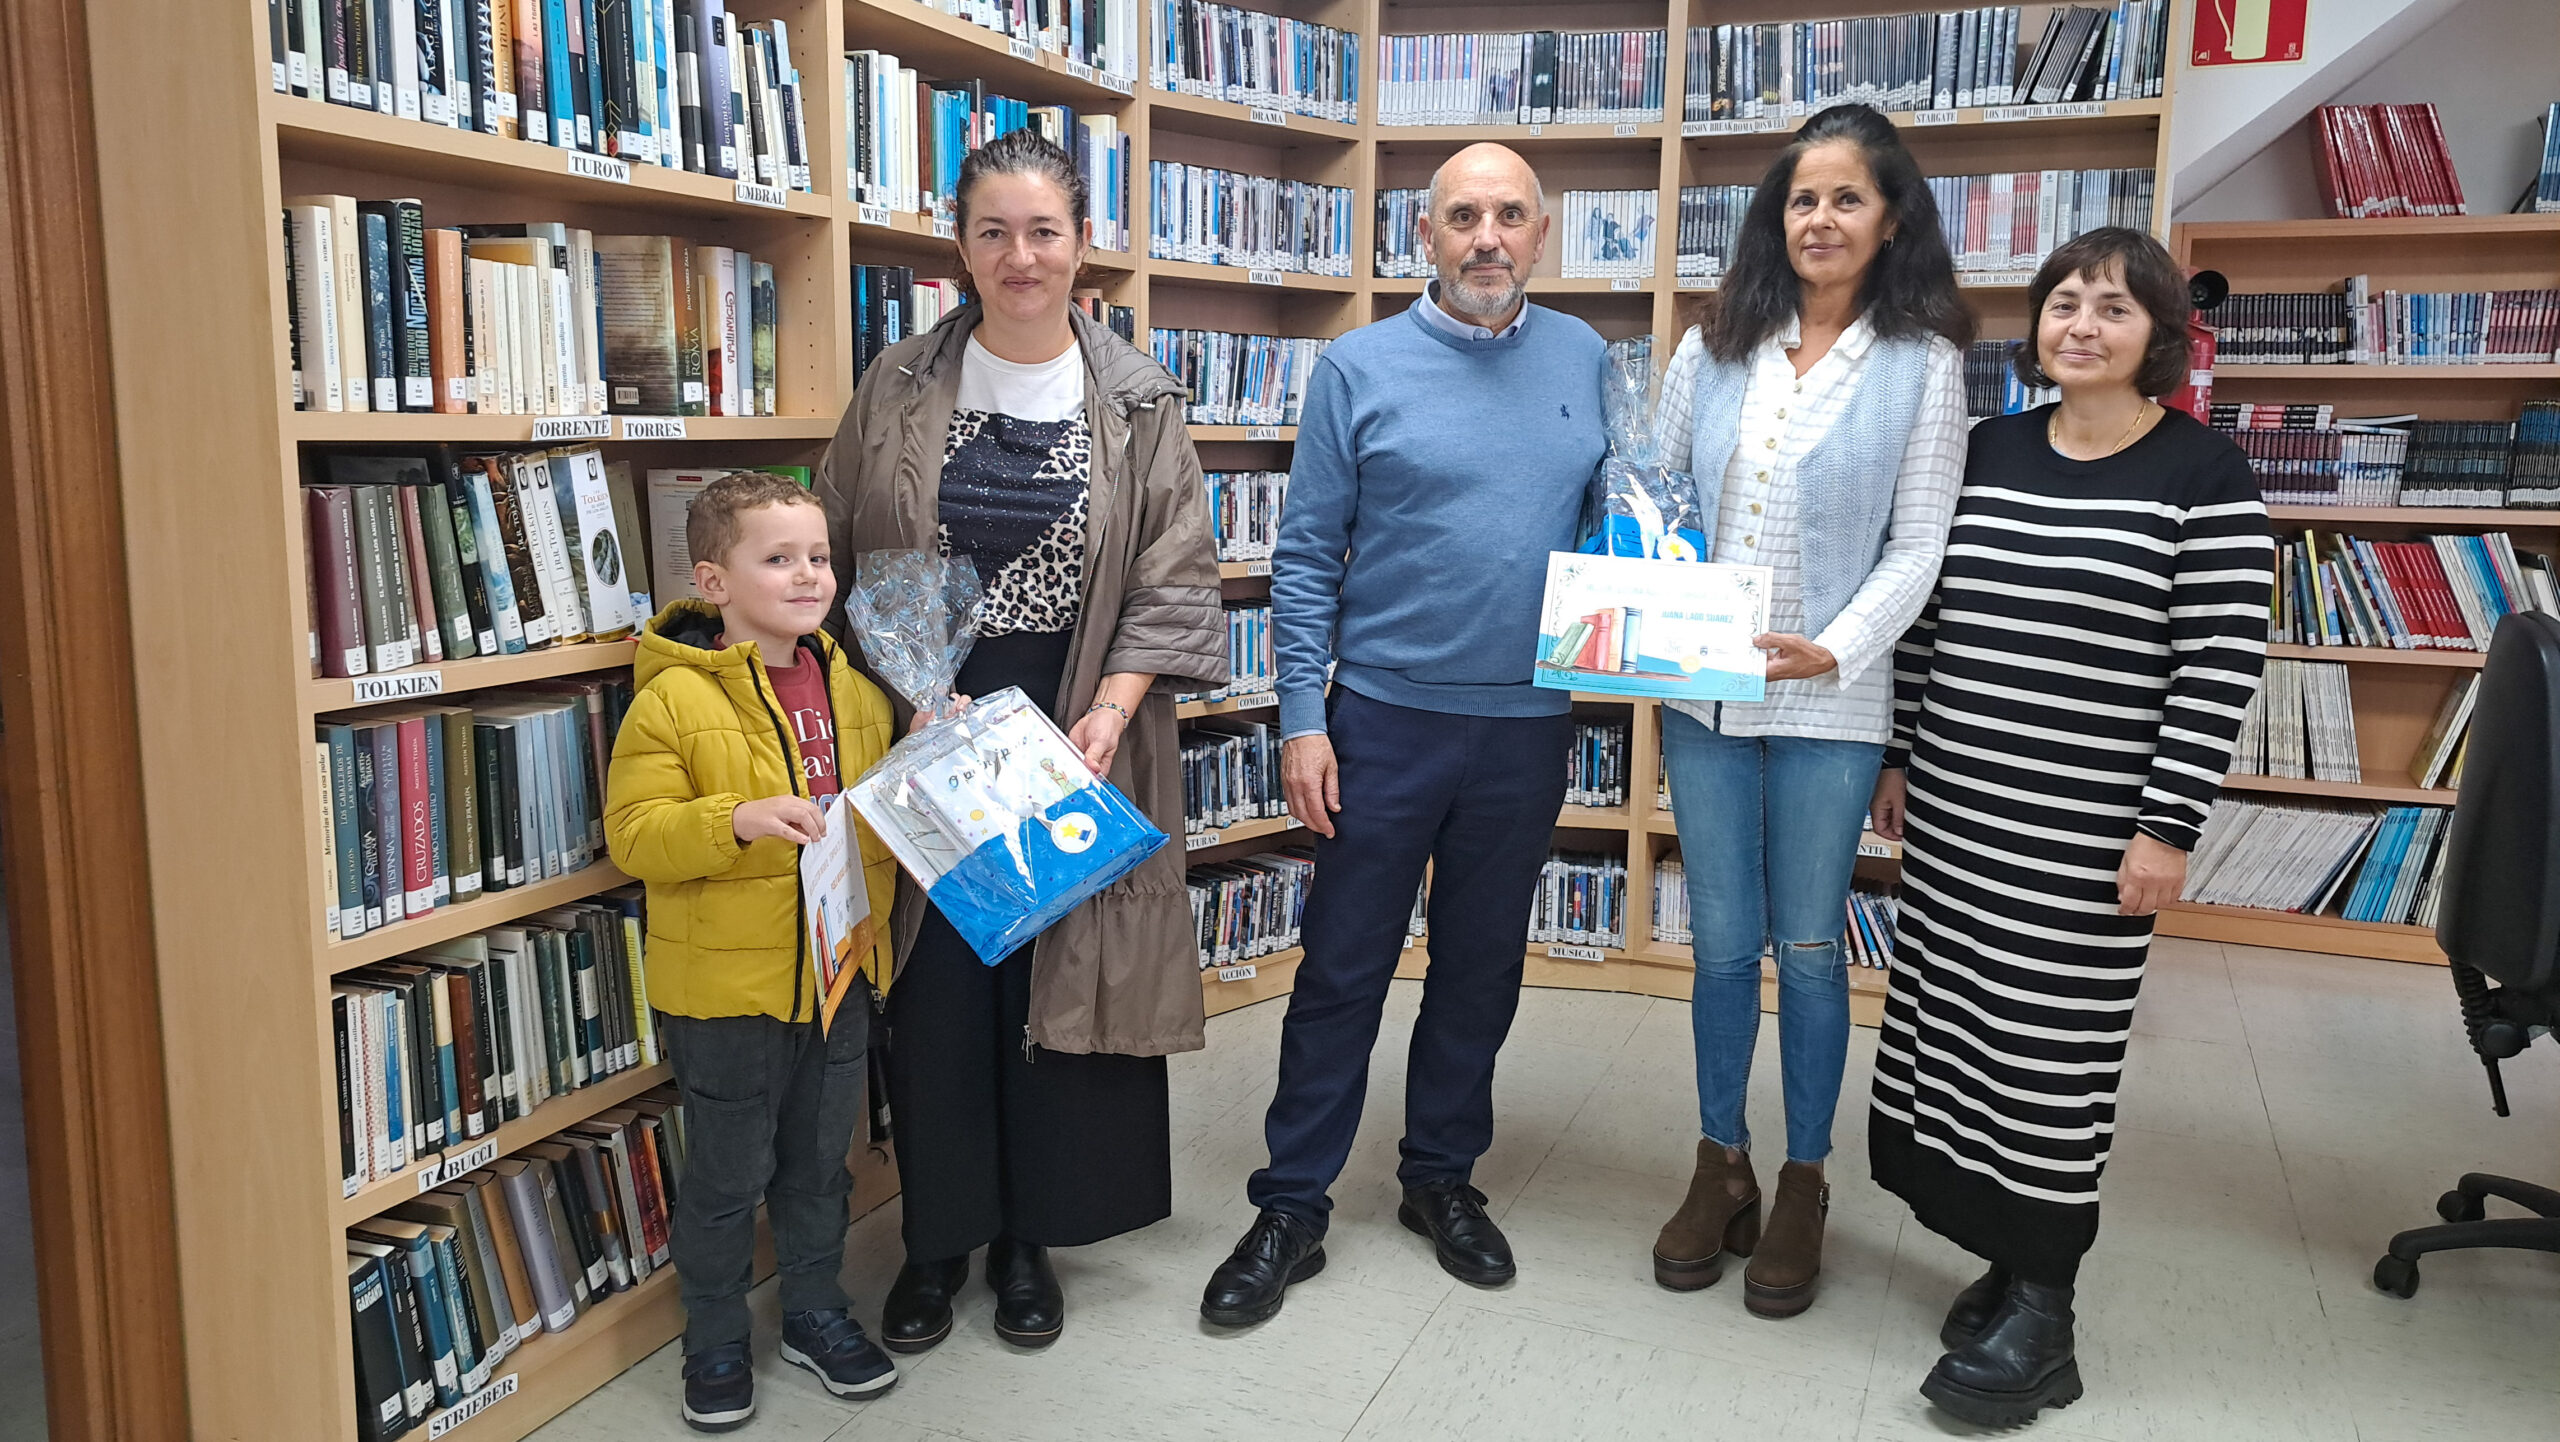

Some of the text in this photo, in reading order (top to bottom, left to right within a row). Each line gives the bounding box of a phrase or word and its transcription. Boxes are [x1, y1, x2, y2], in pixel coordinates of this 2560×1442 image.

[1010, 41, 1035, 60] WOOD
[1252, 109, 1283, 124] DRAMA
[1915, 111, 1956, 123] STARGATE
[1985, 109, 1999, 119] LOS
[2028, 105, 2043, 116] THE
[2046, 104, 2084, 115] WALKING
[1615, 124, 1637, 135] ALIAS
[1682, 121, 1732, 134] PRISON BREAK
[571, 155, 627, 181] TUROW
[737, 183, 785, 206] UMBRAL
[861, 207, 889, 224] WEST
[400, 206, 413, 256] CHUCK
[411, 208, 424, 256] HOGAN
[1251, 271, 1279, 283] DRAMA
[1619, 279, 1639, 289] VIDAS
[404, 257, 428, 329] NOCTURNA
[415, 330, 430, 361] TORO
[689, 327, 702, 376] ROMA
[535, 419, 610, 438] TORRENTE
[625, 422, 683, 437] TORRES
[1247, 427, 1277, 439] DRAMA
[506, 484, 521, 527] TOLKIEN
[580, 492, 609, 505] TOLKIEN
[369, 507, 378, 537] ANILLOS
[388, 506, 396, 535] ANILLOS
[524, 502, 541, 550] TOLKIEN
[543, 499, 560, 549] TOLKIEN
[376, 565, 384, 587] SEÑOR
[394, 562, 402, 585] SEÑOR
[1248, 562, 1273, 574] COME
[1660, 609, 1684, 620] JUANA
[357, 674, 440, 700] TOLKIEN
[1239, 694, 1275, 708] COMEDIA
[318, 753, 327, 774] polar
[345, 756, 354, 792] SOMBRAS
[335, 743, 348, 825] LOS CABALLEROS DE
[322, 805, 329, 815] de
[323, 817, 332, 856] Memorias
[412, 800, 428, 882] CRUZADOS
[1859, 844, 1887, 856] NTIL
[385, 840, 397, 891] HISPANIA
[349, 874, 357, 893] JUAN
[1552, 947, 1599, 959] MUSICAL
[1220, 966, 1252, 981] ACCIÓN
[476, 968, 487, 1007] TAGORE
[432, 1376, 515, 1438] STRIEBER
